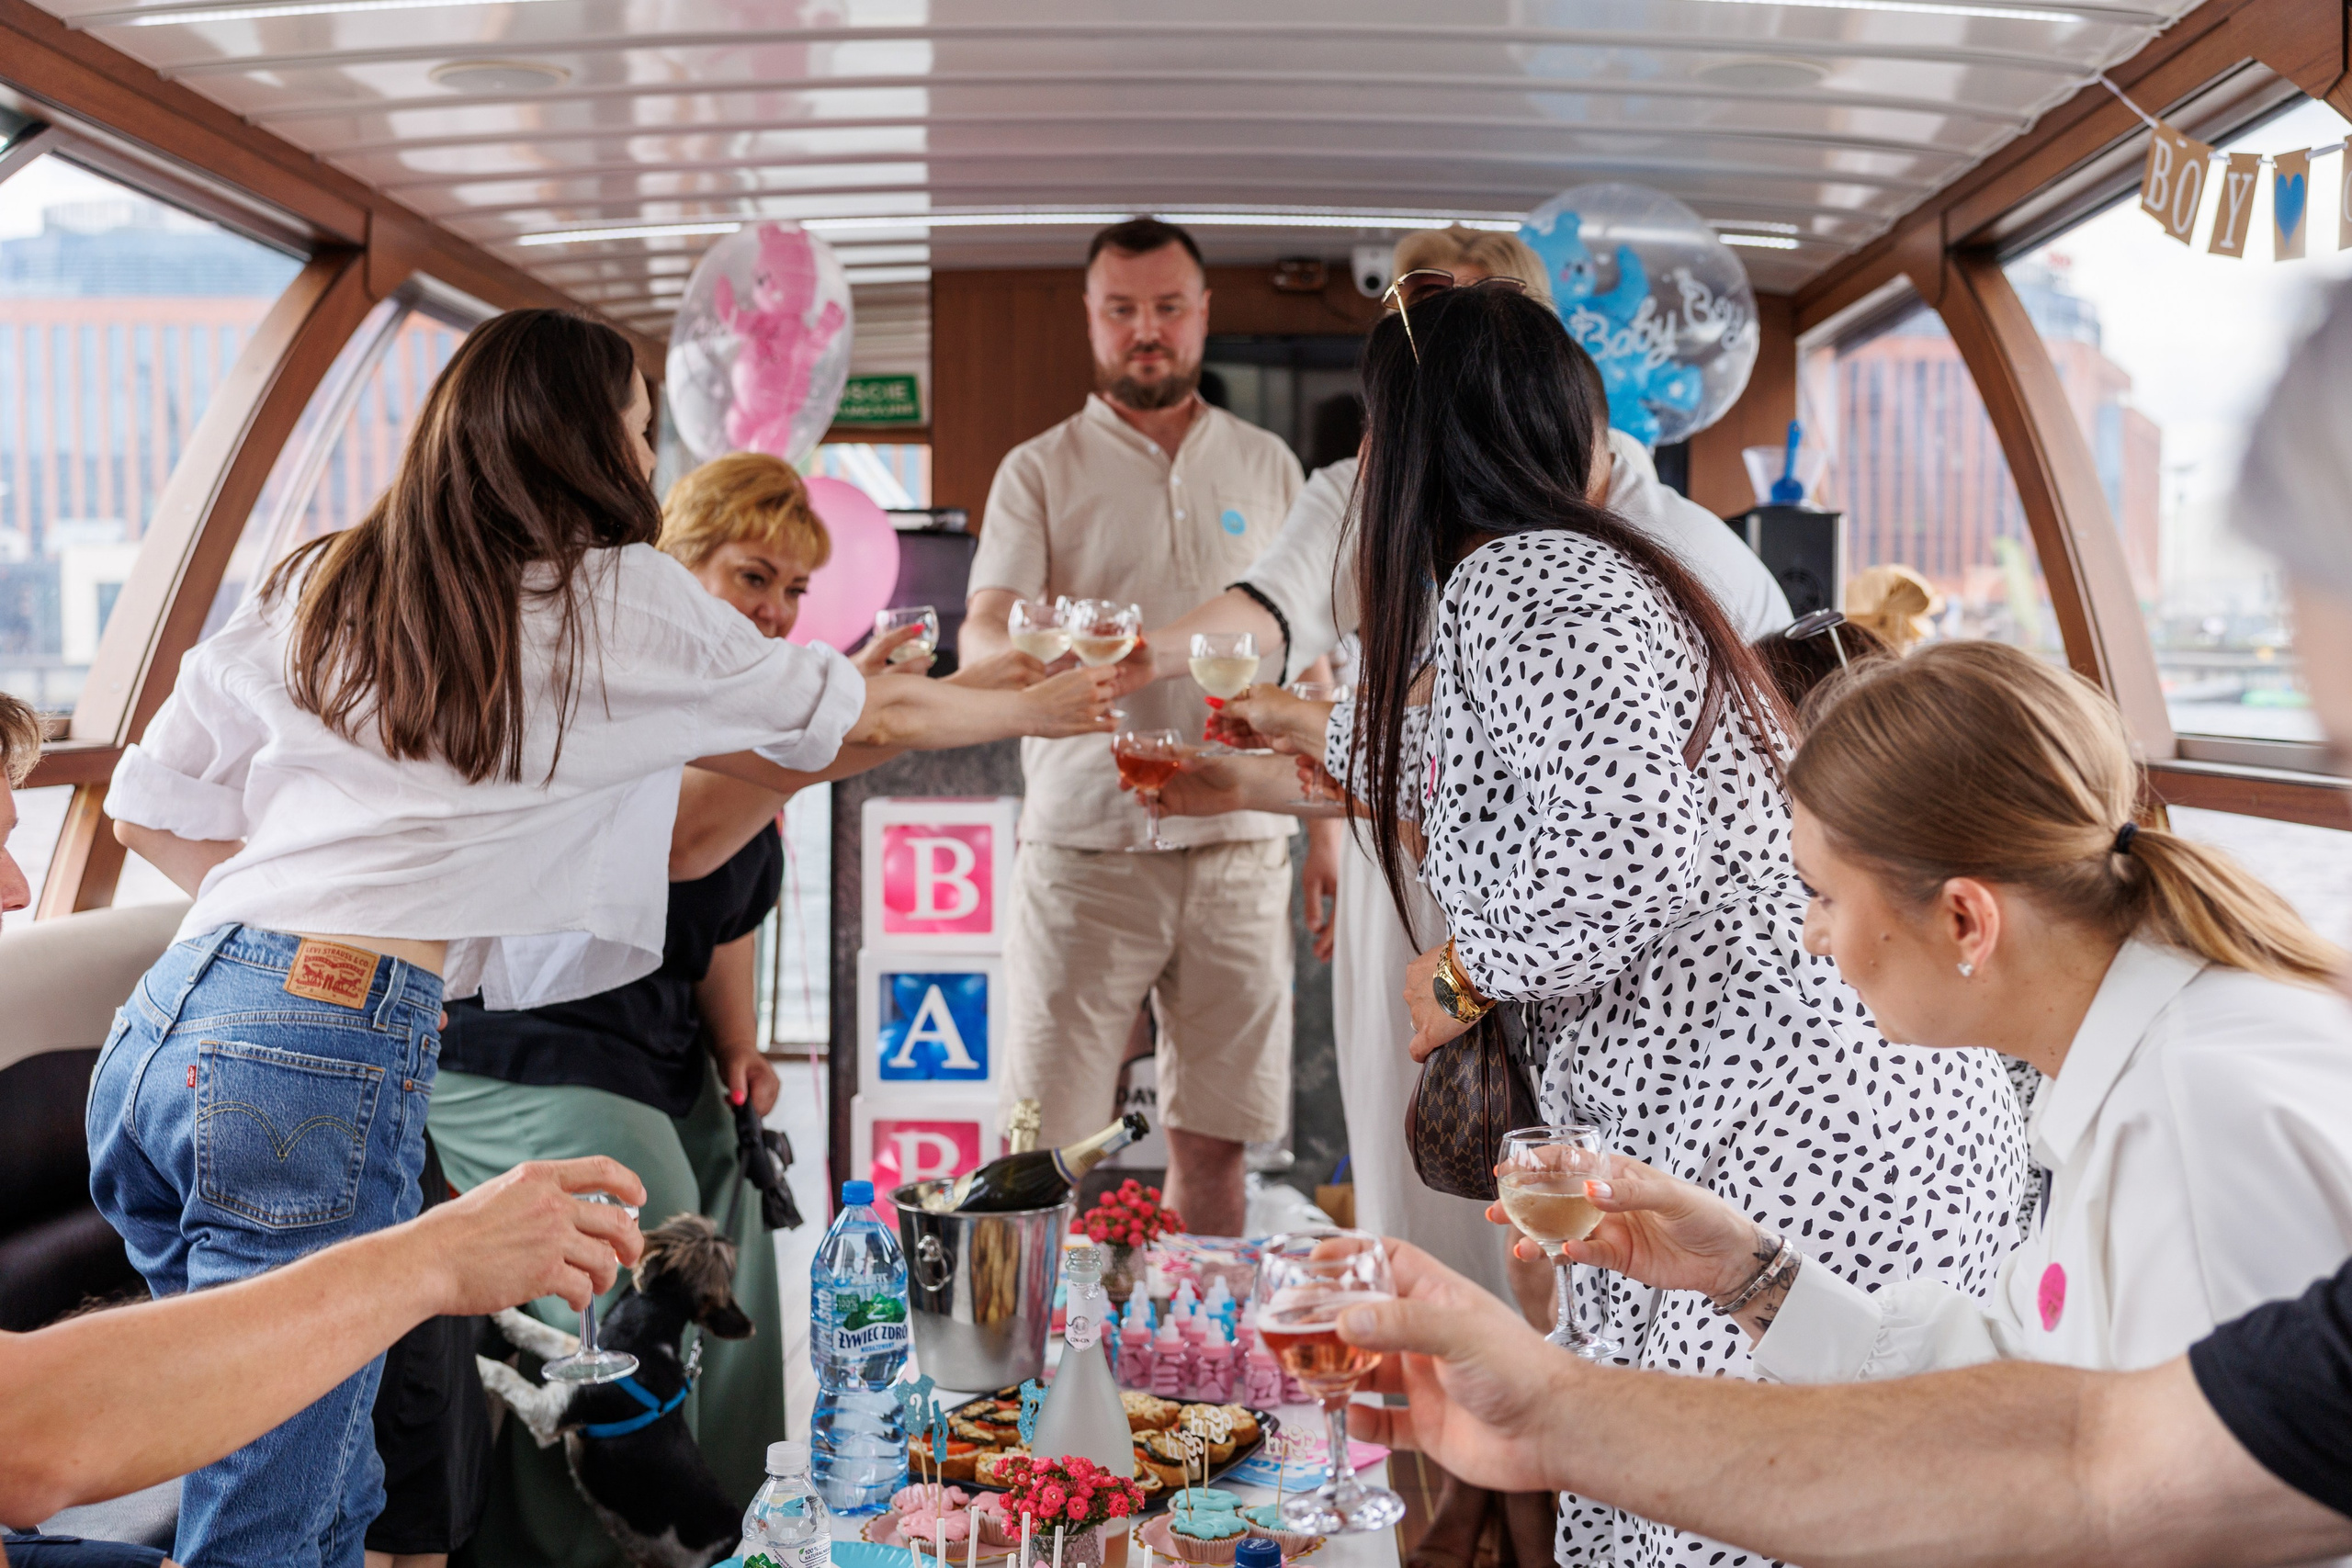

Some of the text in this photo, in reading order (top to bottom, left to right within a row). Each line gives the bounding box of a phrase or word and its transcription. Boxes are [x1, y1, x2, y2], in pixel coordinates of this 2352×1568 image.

[2143, 137, 2254, 248] BOY
[1569, 295, 1679, 367] Baby
[322, 947, 353, 961] STRAUSS
[838, 1324, 908, 1349] ŻYWIEC ZDRÓ
